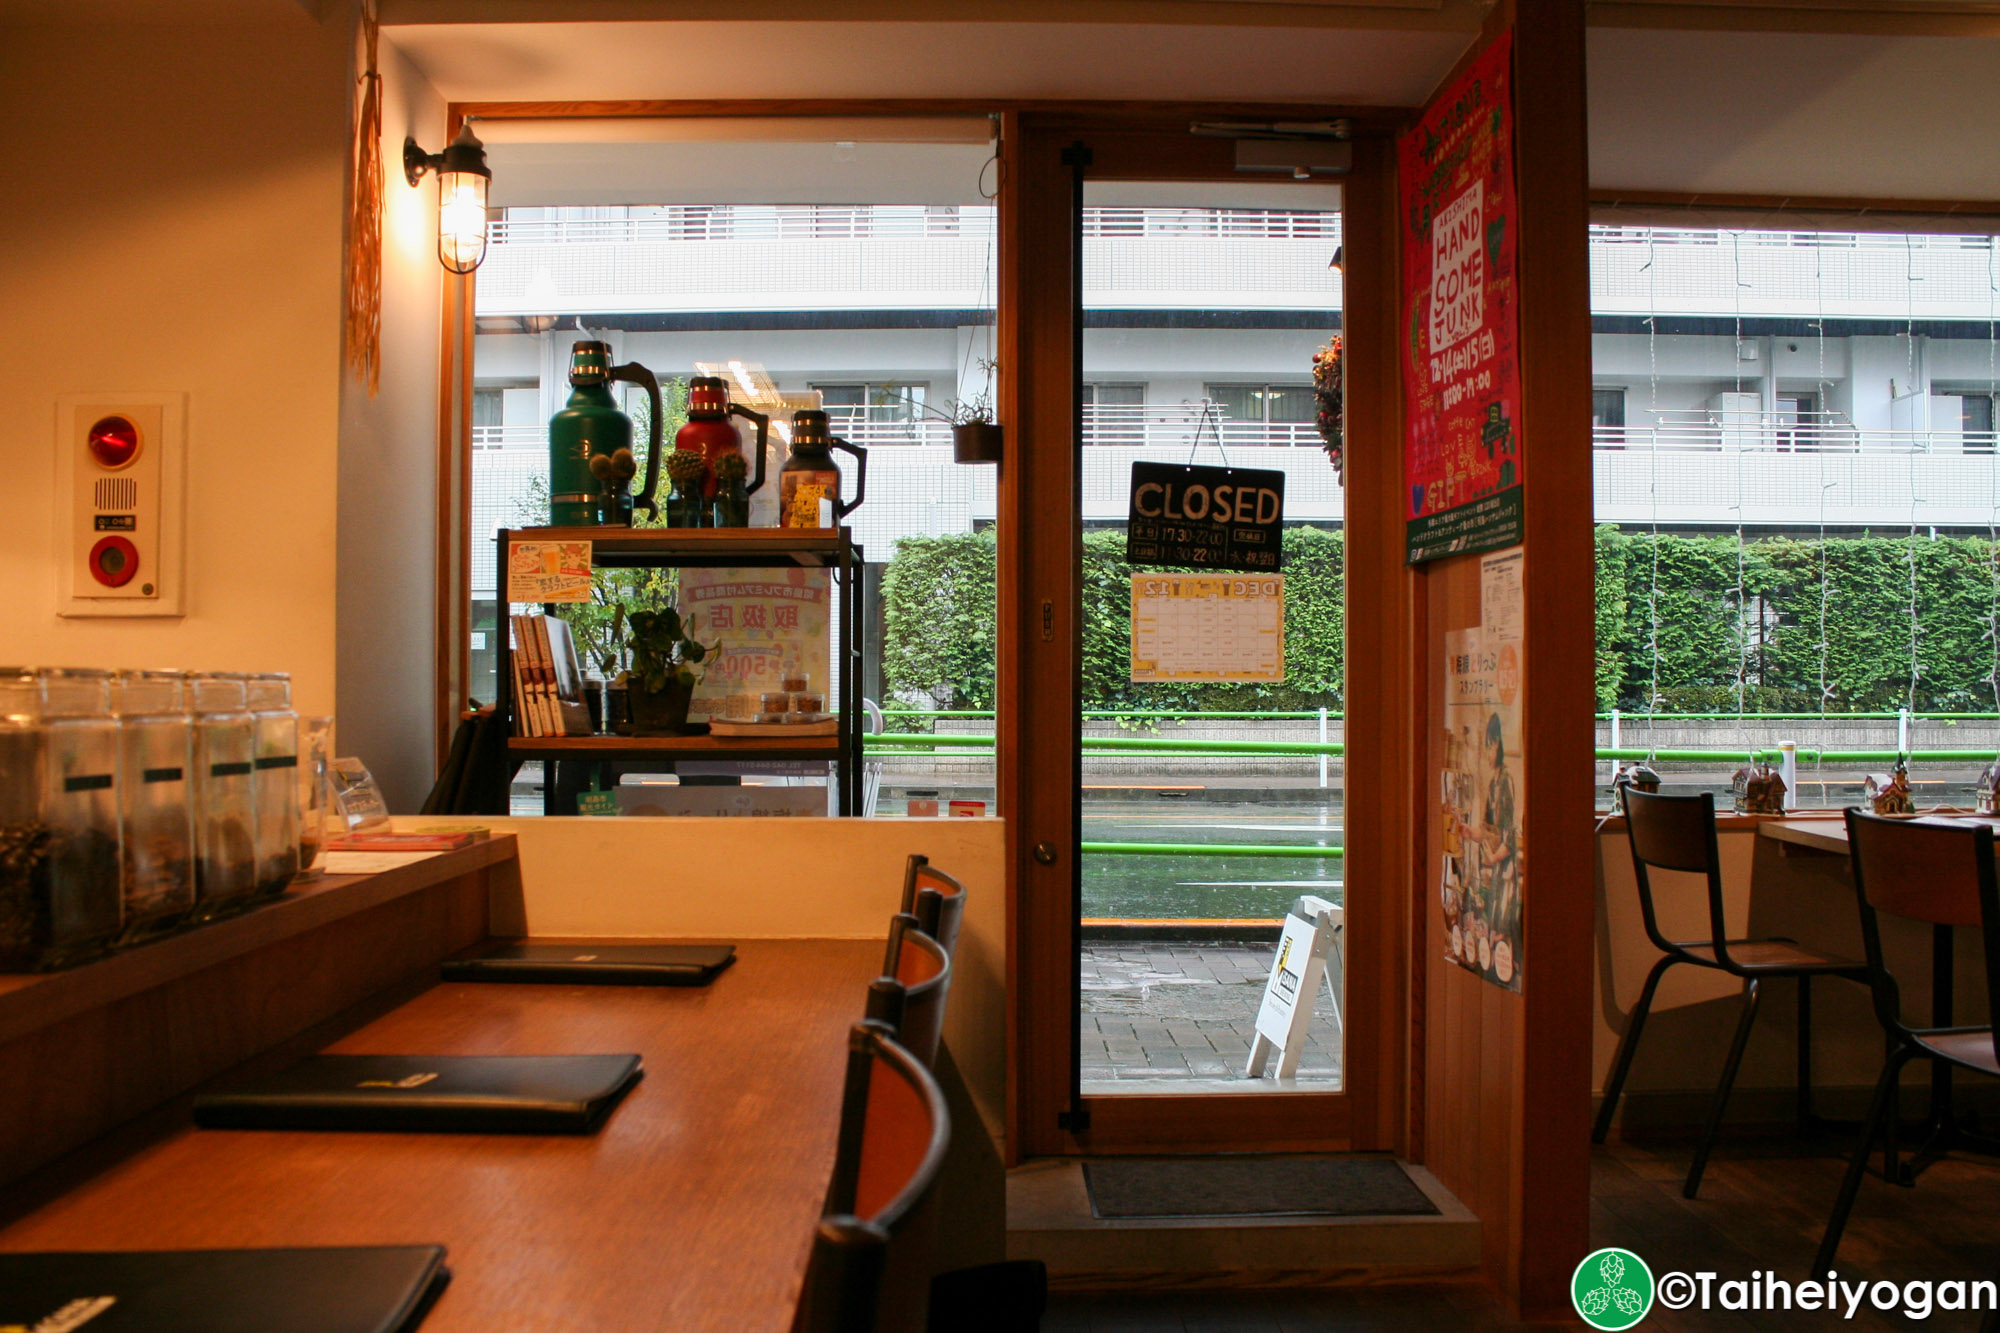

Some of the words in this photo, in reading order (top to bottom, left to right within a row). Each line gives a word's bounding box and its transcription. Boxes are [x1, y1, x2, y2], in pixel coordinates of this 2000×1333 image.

[1439, 188, 1478, 229] AKISHIMA
[1436, 206, 1481, 269] HAND
[1434, 248, 1482, 318] SOME
[1434, 292, 1480, 345] JUNK
[1134, 481, 1281, 525] CLOSED
